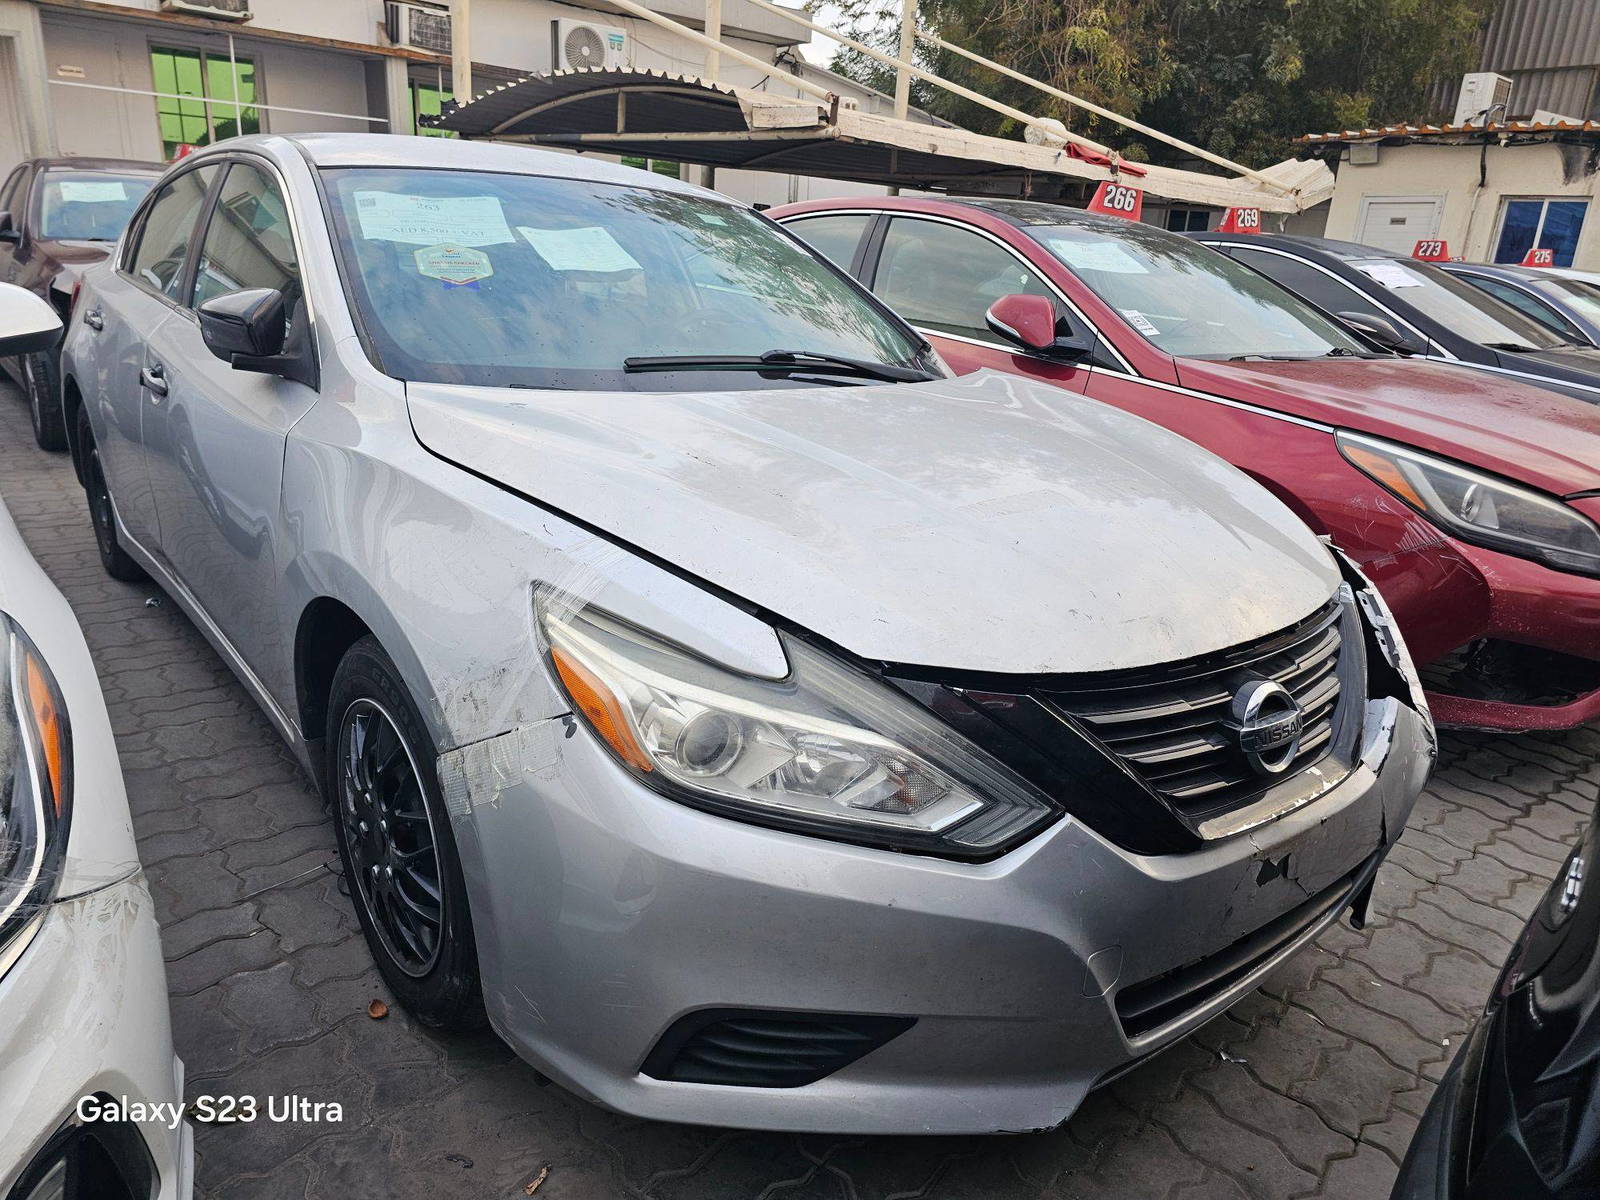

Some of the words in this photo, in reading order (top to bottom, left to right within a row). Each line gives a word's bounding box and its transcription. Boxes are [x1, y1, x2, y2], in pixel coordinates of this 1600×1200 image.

[1103, 184, 1137, 212] 266
[1237, 208, 1258, 227] 269
[1418, 241, 1442, 256] 273
[1534, 251, 1551, 263] 275
[1254, 716, 1303, 747] NISSAN
